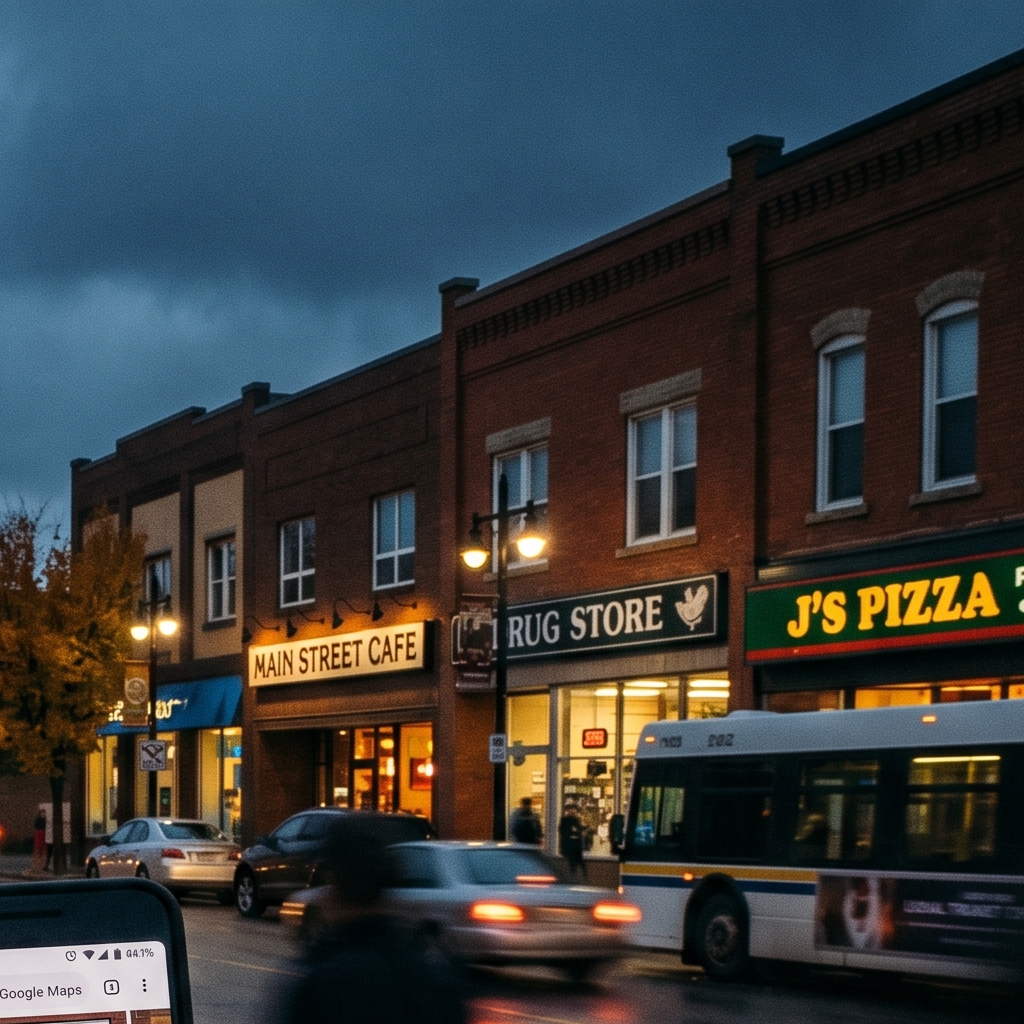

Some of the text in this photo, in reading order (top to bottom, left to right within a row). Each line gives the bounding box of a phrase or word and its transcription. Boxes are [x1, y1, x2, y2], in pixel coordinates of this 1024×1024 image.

[492, 595, 664, 650] RUG STORE
[787, 590, 847, 638] J'S
[857, 571, 1001, 631] PIZZA
[254, 631, 417, 679] MAIN STREET CAFE
[0, 987, 44, 1001] Google
[47, 985, 82, 998] Maps
